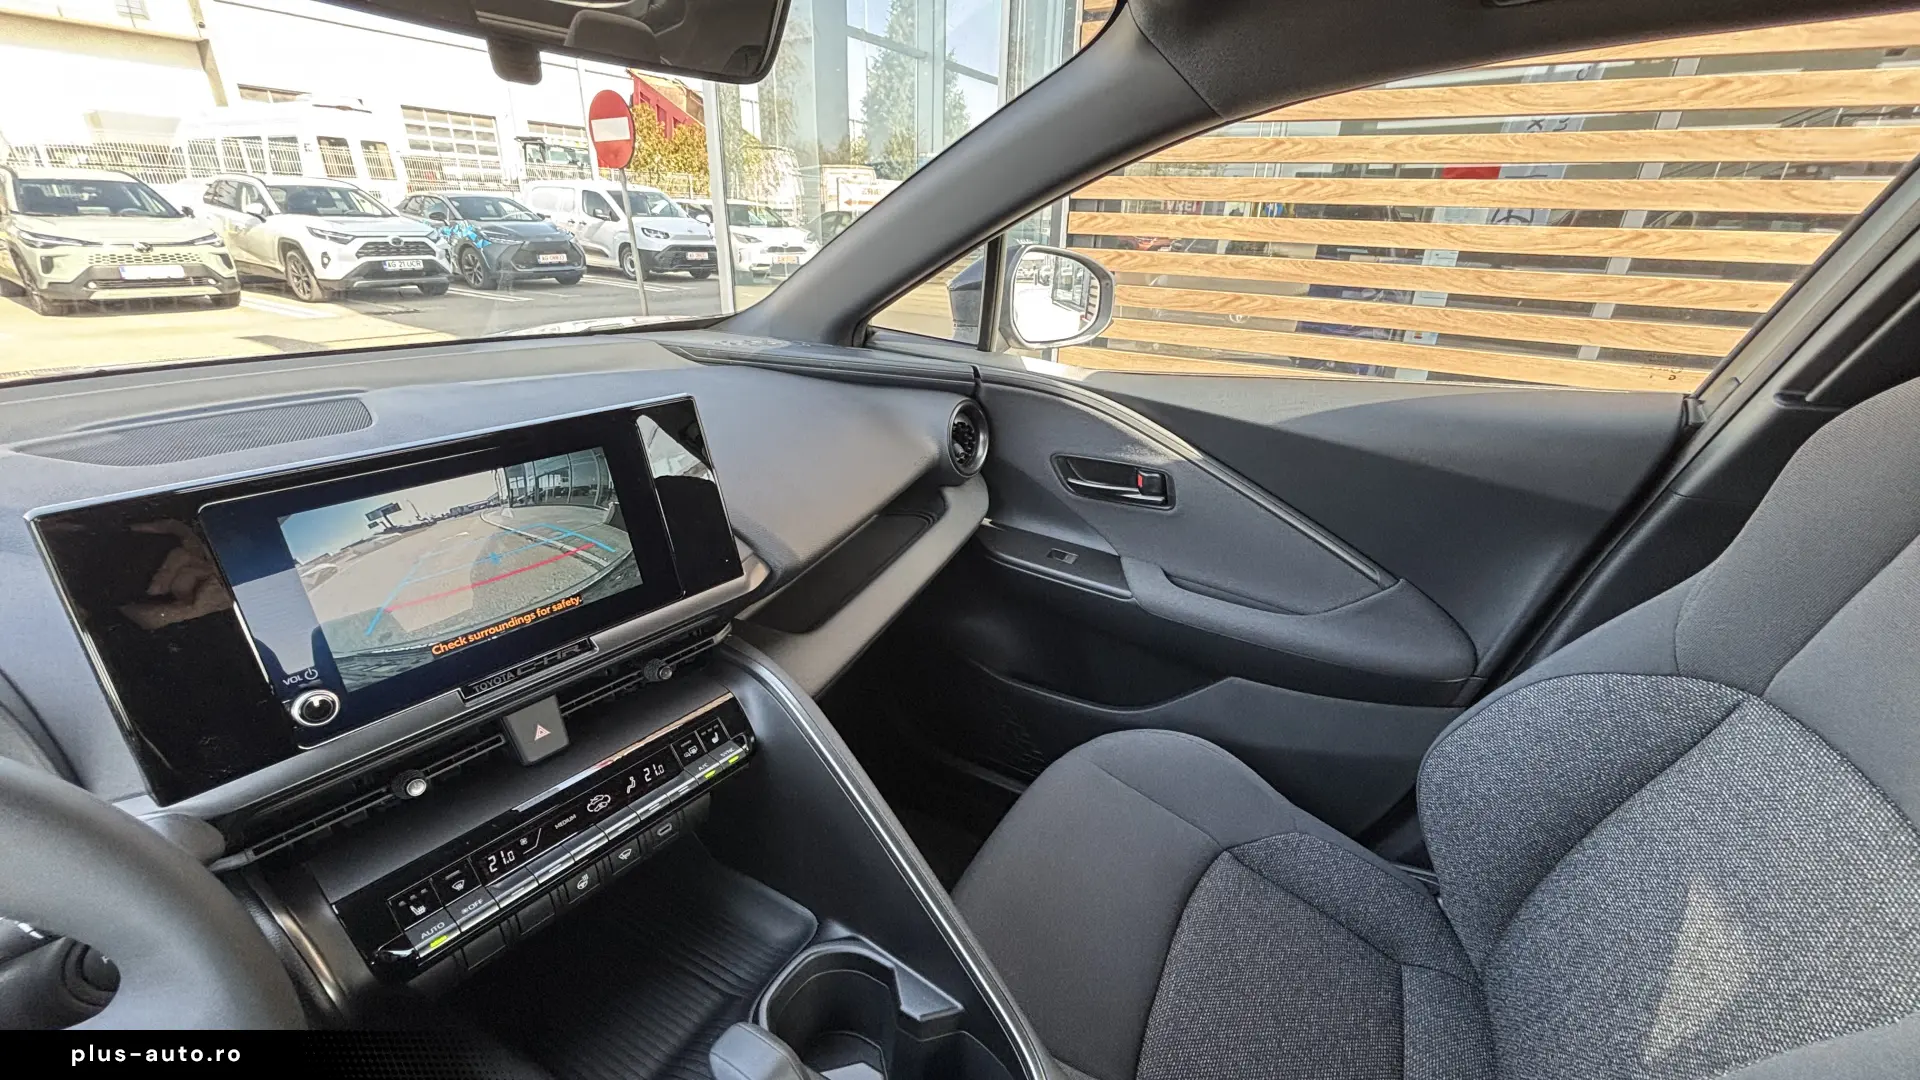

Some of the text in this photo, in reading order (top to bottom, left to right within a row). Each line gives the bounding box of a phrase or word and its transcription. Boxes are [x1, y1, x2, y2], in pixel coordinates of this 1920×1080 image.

[431, 595, 583, 655] Check surroundings for safety.
[472, 644, 581, 693] TOYOTA C-HR
[282, 674, 304, 685] VOL
[643, 763, 665, 782] 21.0
[554, 813, 577, 829] MEDIUM
[487, 850, 516, 873] 21.0
[467, 898, 483, 911] OFF
[420, 921, 446, 940] AUTO
